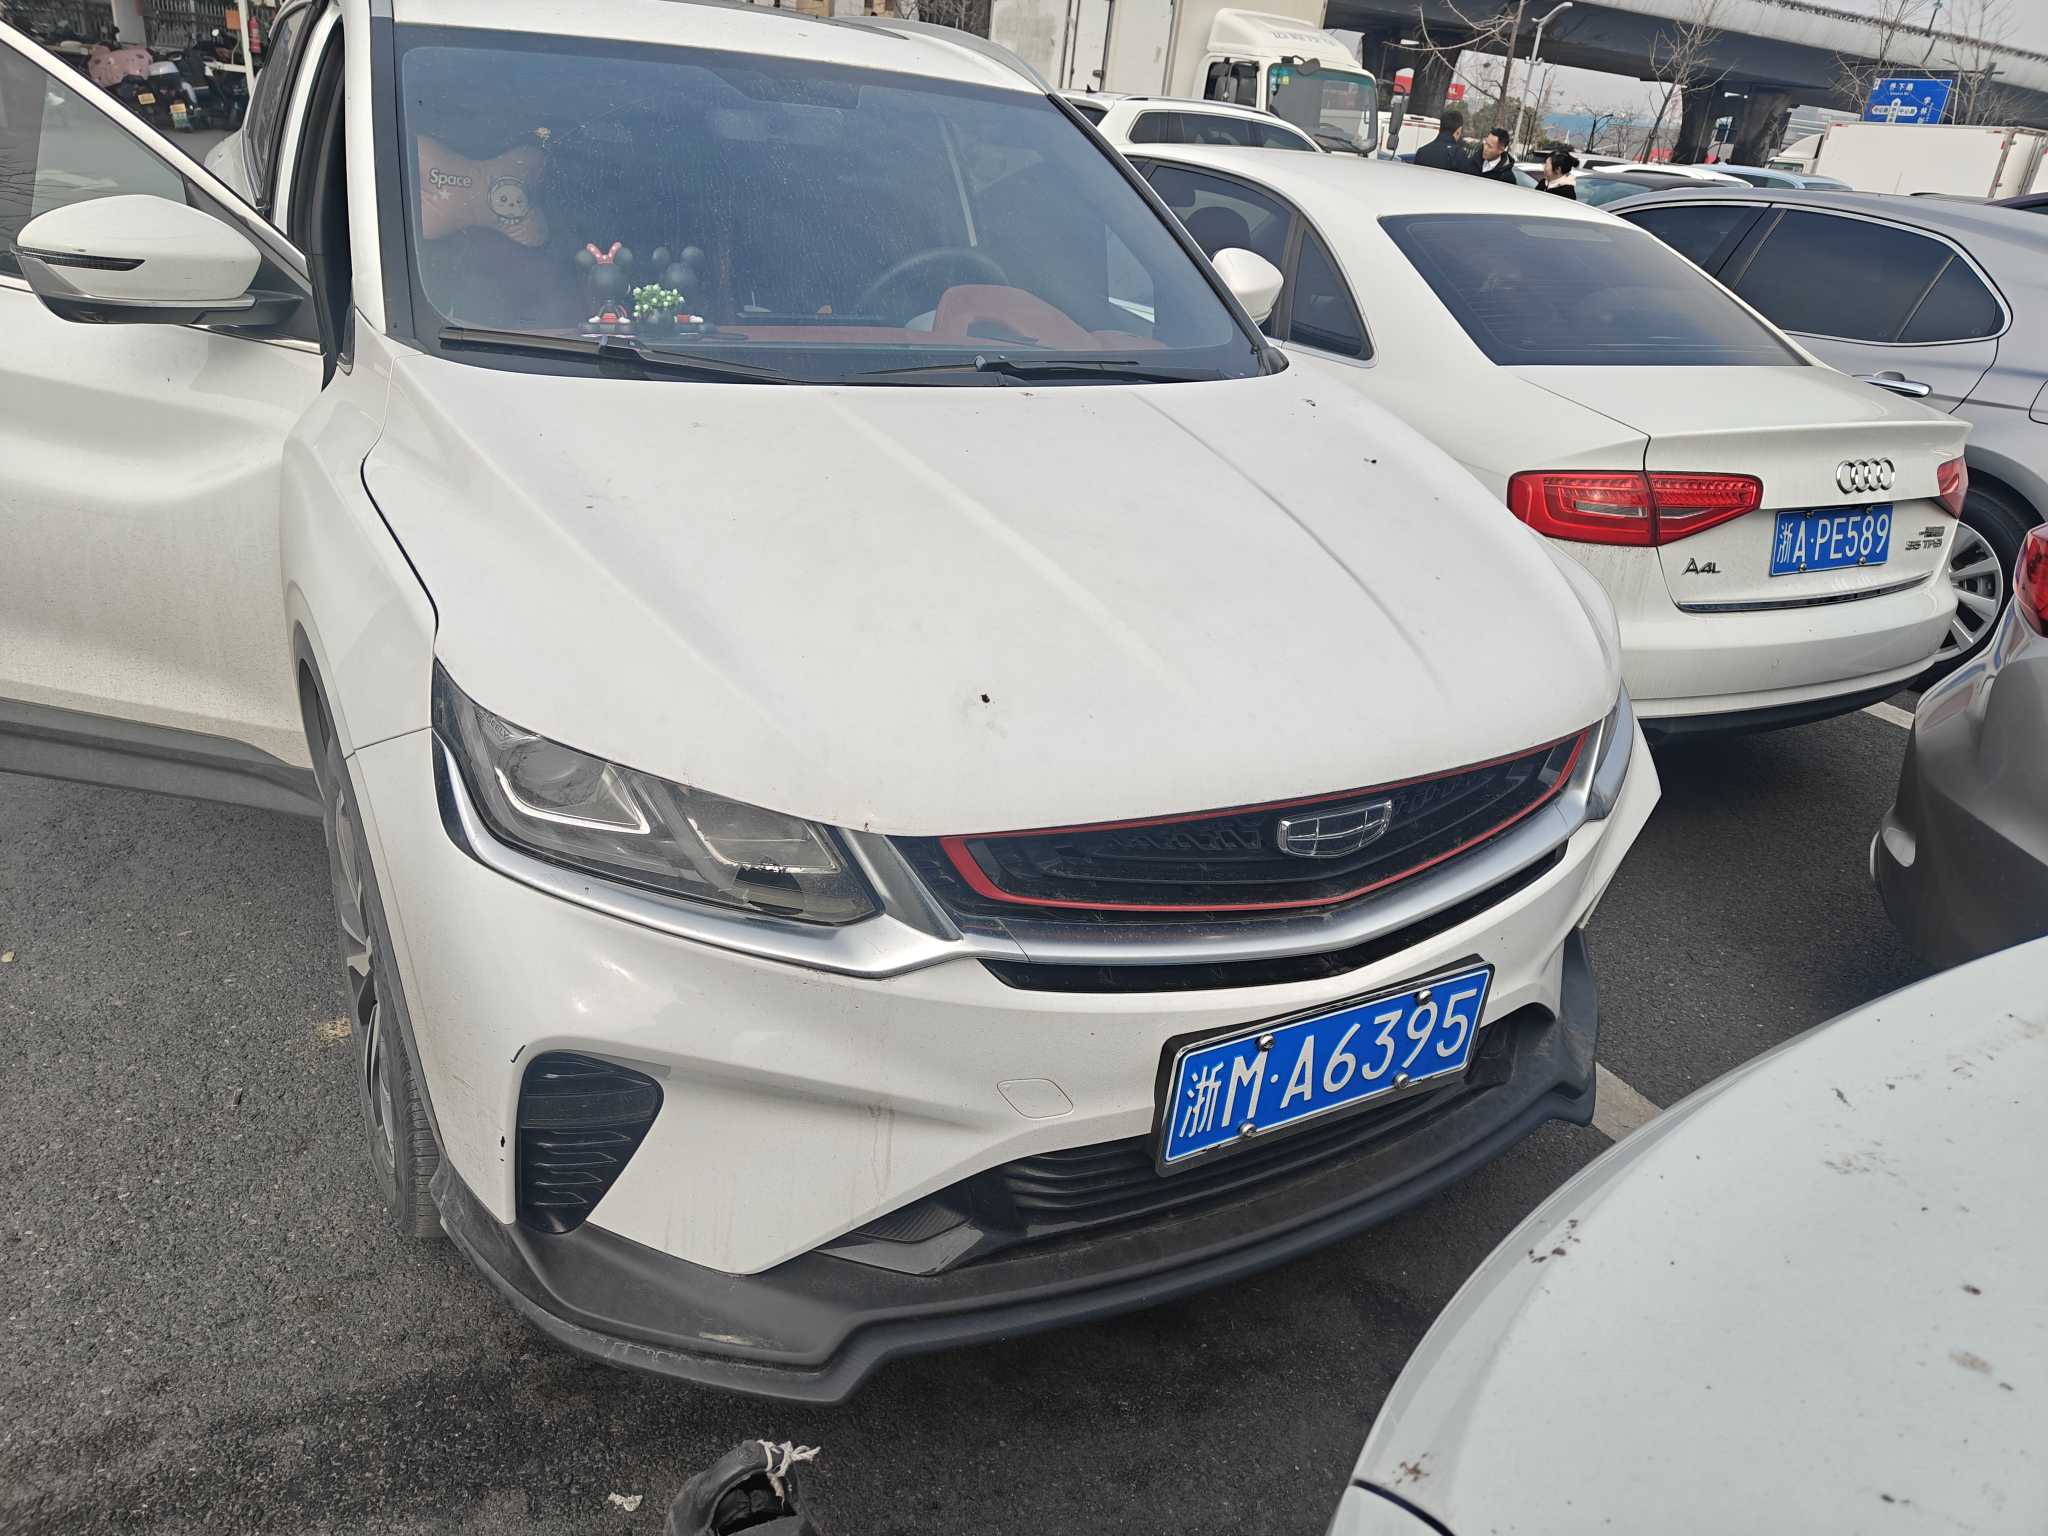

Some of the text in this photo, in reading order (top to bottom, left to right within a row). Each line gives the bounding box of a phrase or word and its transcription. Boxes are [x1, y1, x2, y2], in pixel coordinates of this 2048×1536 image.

[429, 168, 472, 188] Space
[1681, 557, 1721, 576] A4L
[486, 714, 510, 737] GEELY
